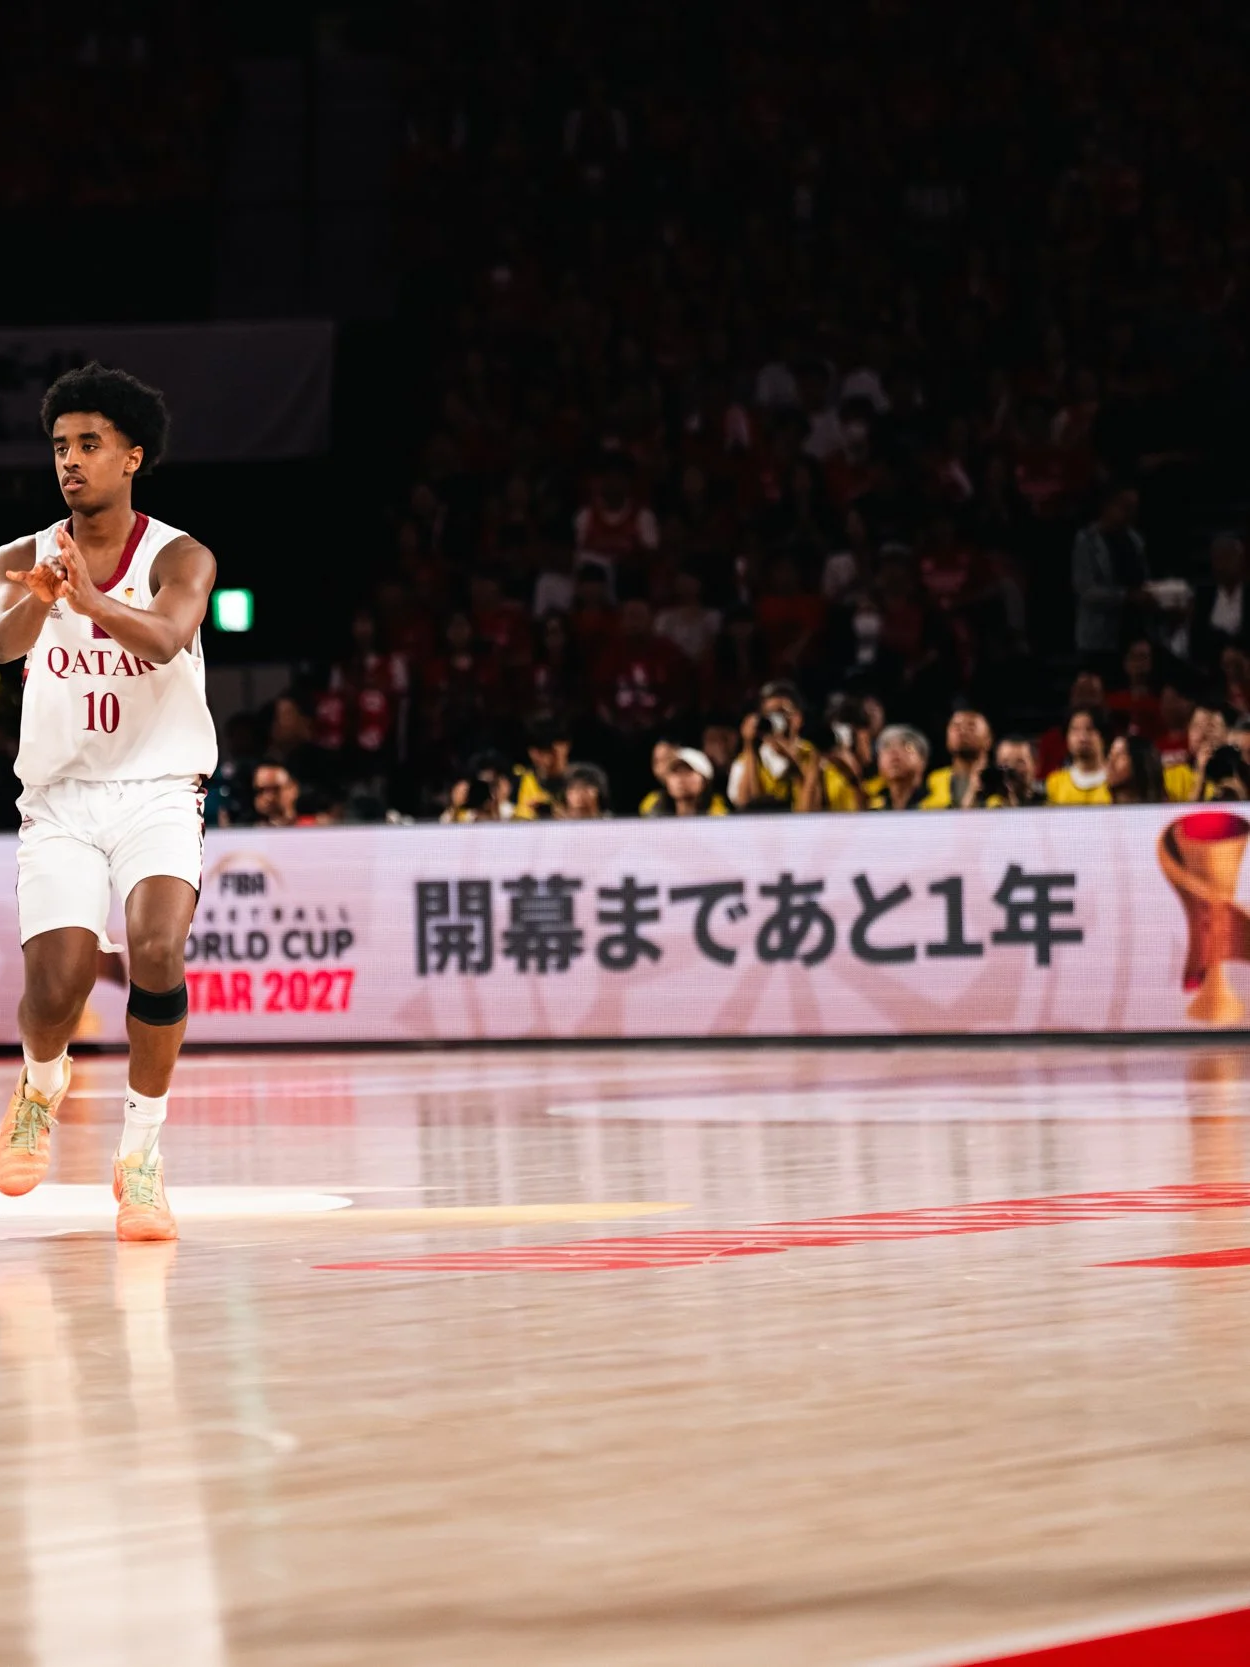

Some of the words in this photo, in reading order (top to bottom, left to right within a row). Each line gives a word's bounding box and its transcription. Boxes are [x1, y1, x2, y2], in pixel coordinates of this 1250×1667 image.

[82, 691, 120, 734] 10
[414, 864, 1085, 976] 開幕まであと1年
[183, 930, 270, 963] ORLD
[281, 928, 355, 961] CUP
[184, 969, 253, 1014] TAR
[262, 967, 356, 1014] 2027
